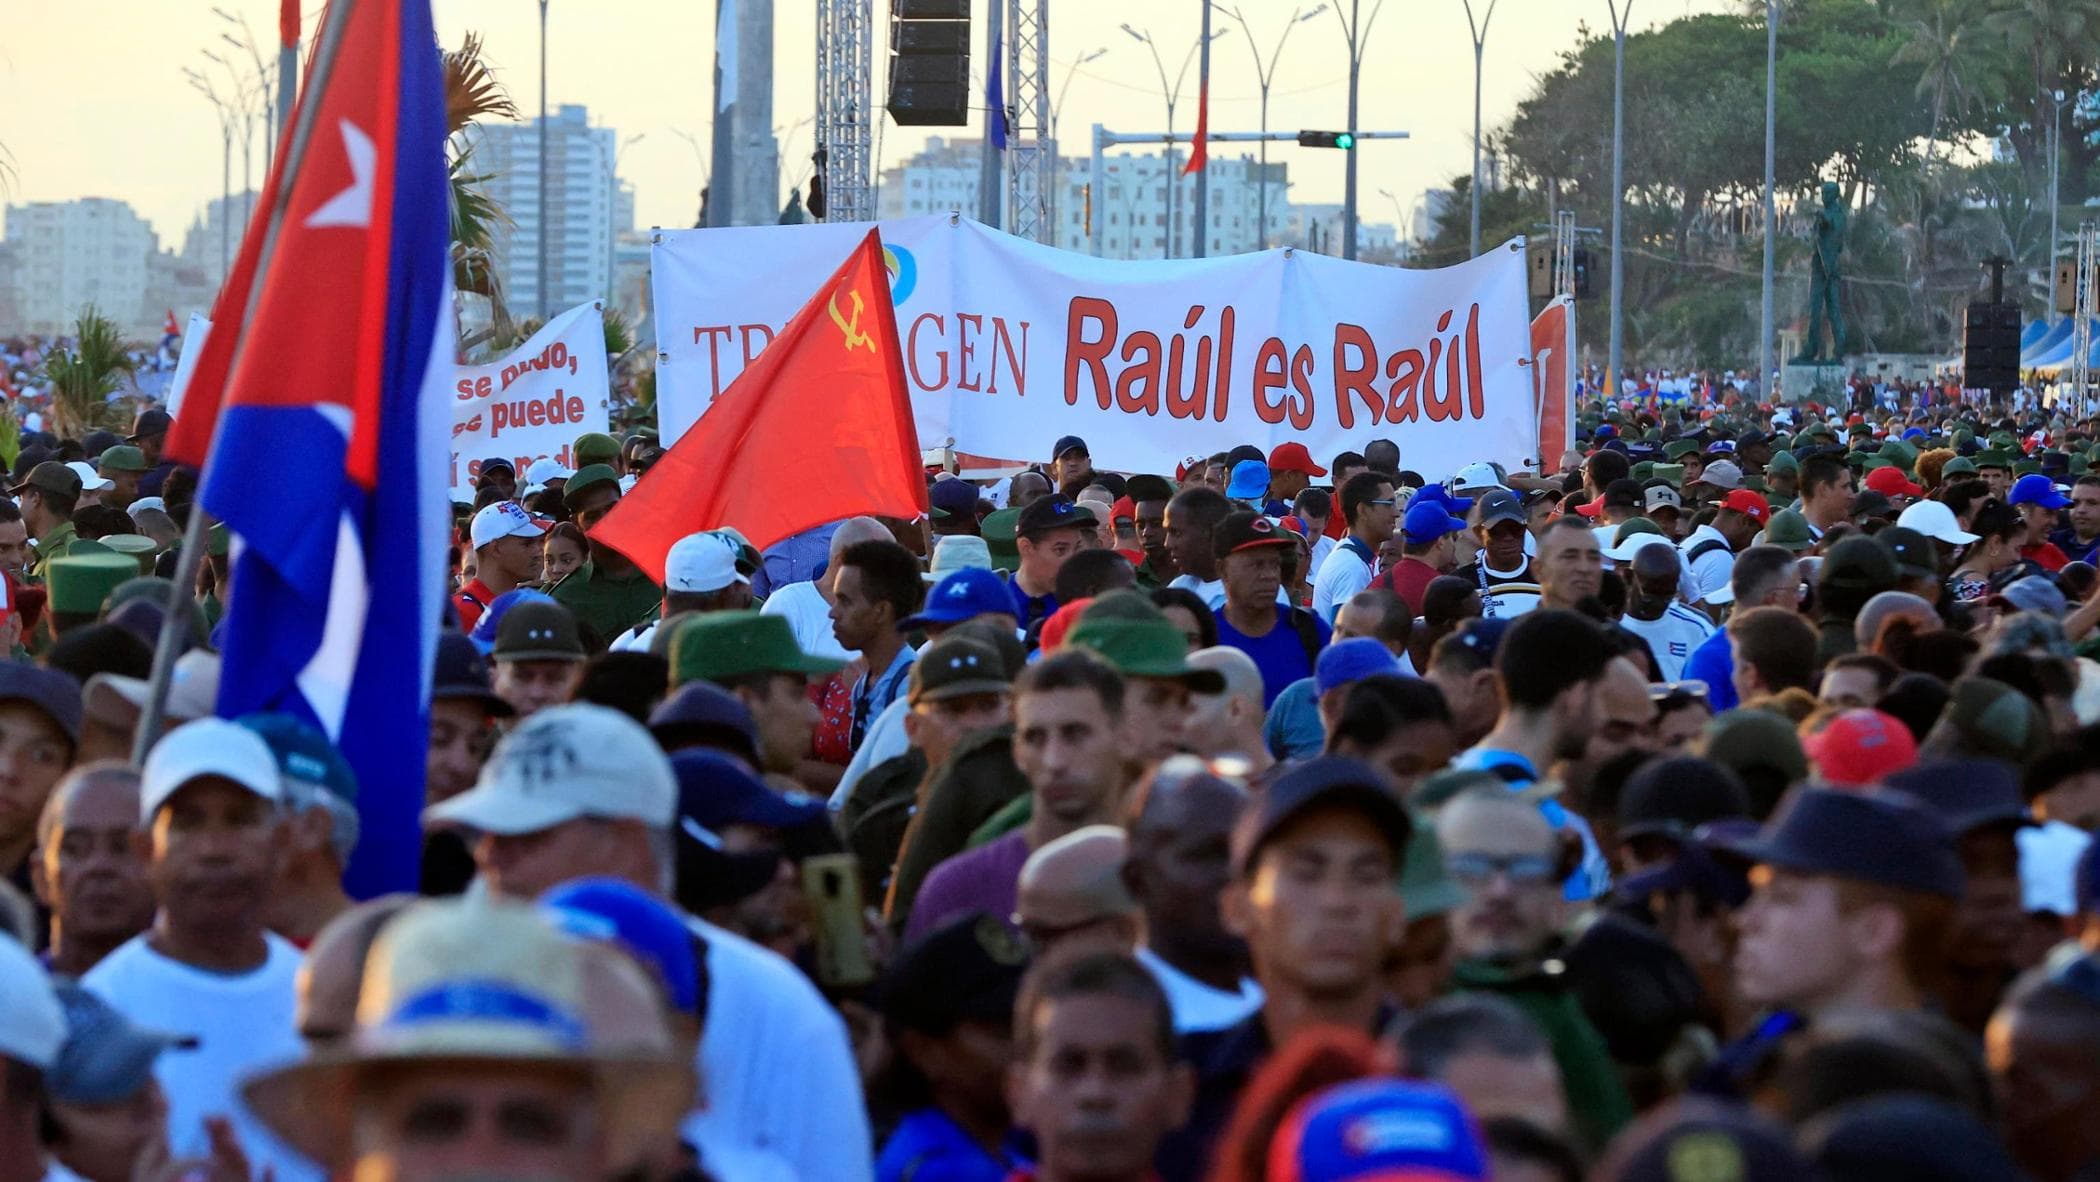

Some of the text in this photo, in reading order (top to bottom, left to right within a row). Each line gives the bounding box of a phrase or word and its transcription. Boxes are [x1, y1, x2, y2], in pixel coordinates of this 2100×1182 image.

[456, 375, 493, 400] se
[694, 312, 1031, 402] TRGEN
[1065, 297, 1234, 421] Raúl
[1254, 338, 1313, 429] es
[1334, 305, 1483, 428] Raúl
[491, 389, 584, 438] puede
